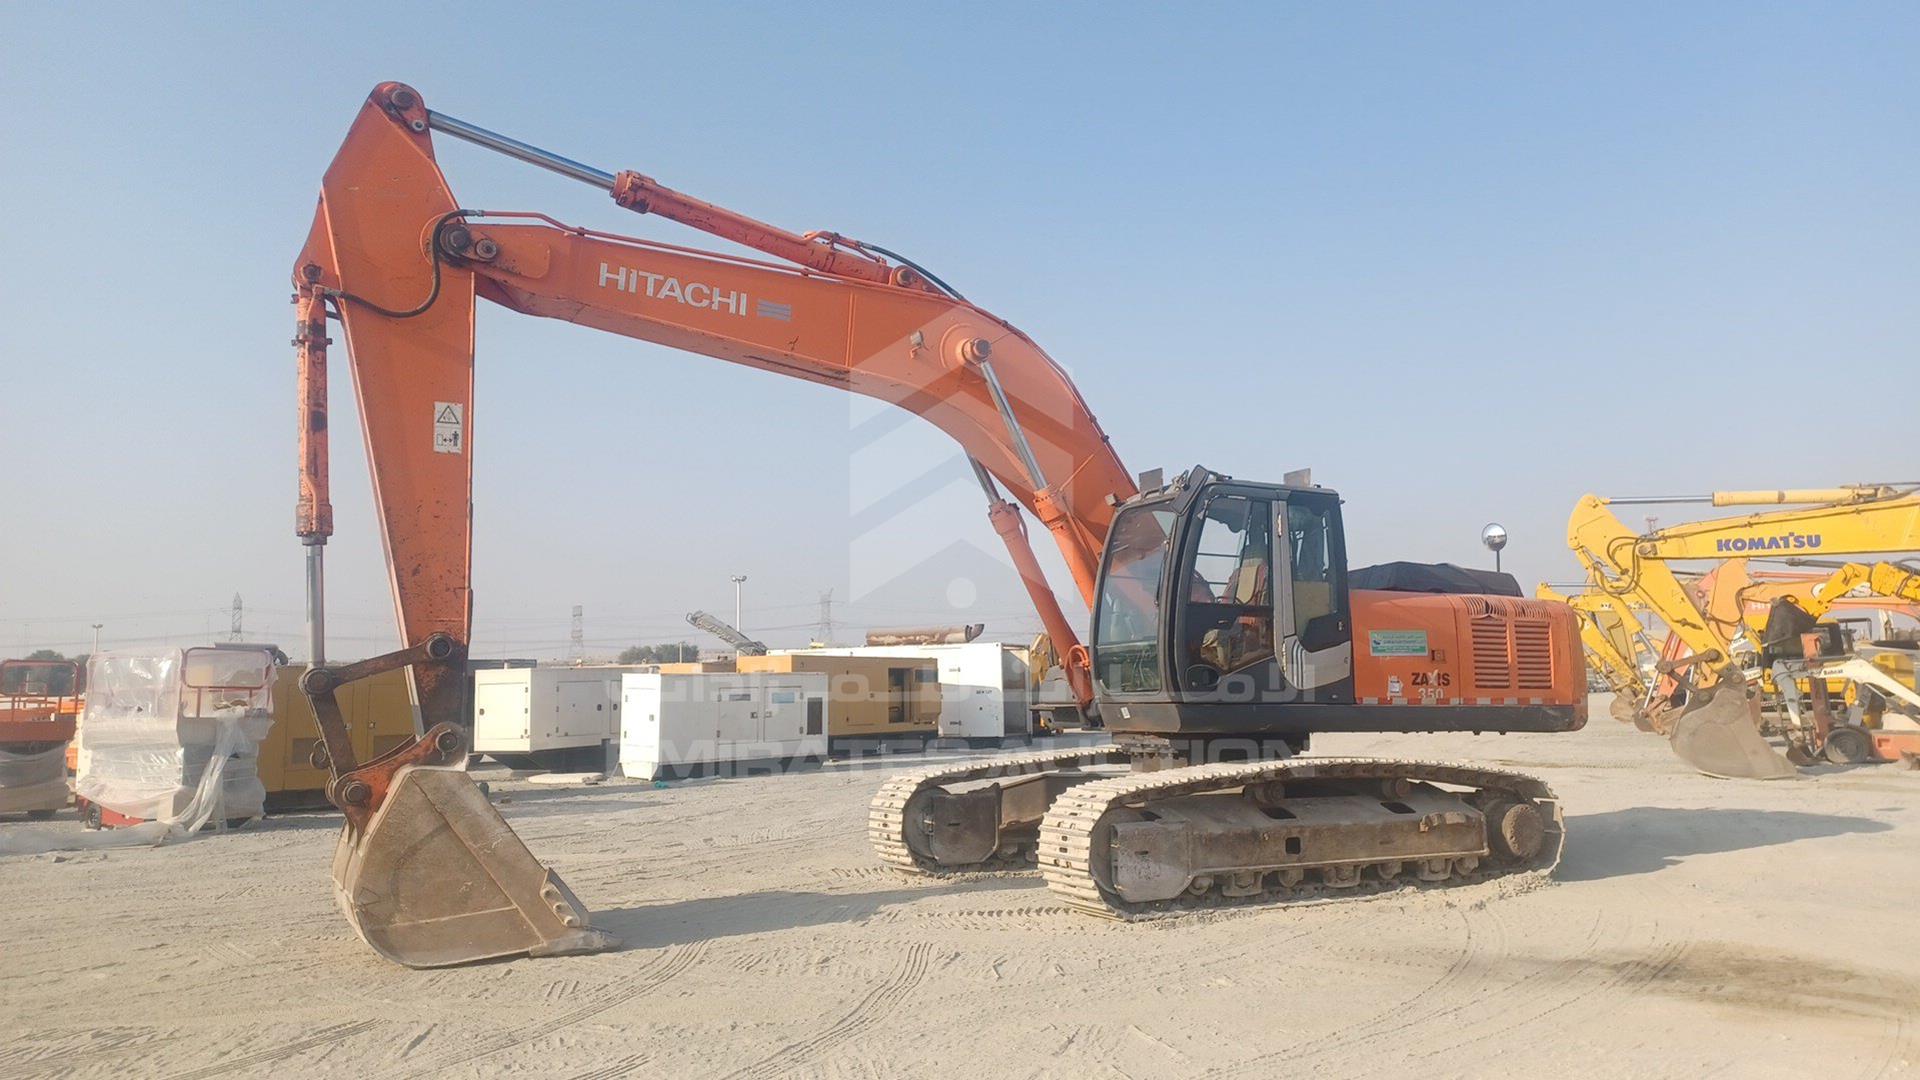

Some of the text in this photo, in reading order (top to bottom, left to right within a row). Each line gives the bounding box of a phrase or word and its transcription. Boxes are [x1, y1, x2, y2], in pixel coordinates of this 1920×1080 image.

[599, 262, 748, 316] HITACHI
[1716, 532, 1822, 552] KOMATSU
[1411, 669, 1451, 687] ZAXIS
[1418, 688, 1444, 700] 350
